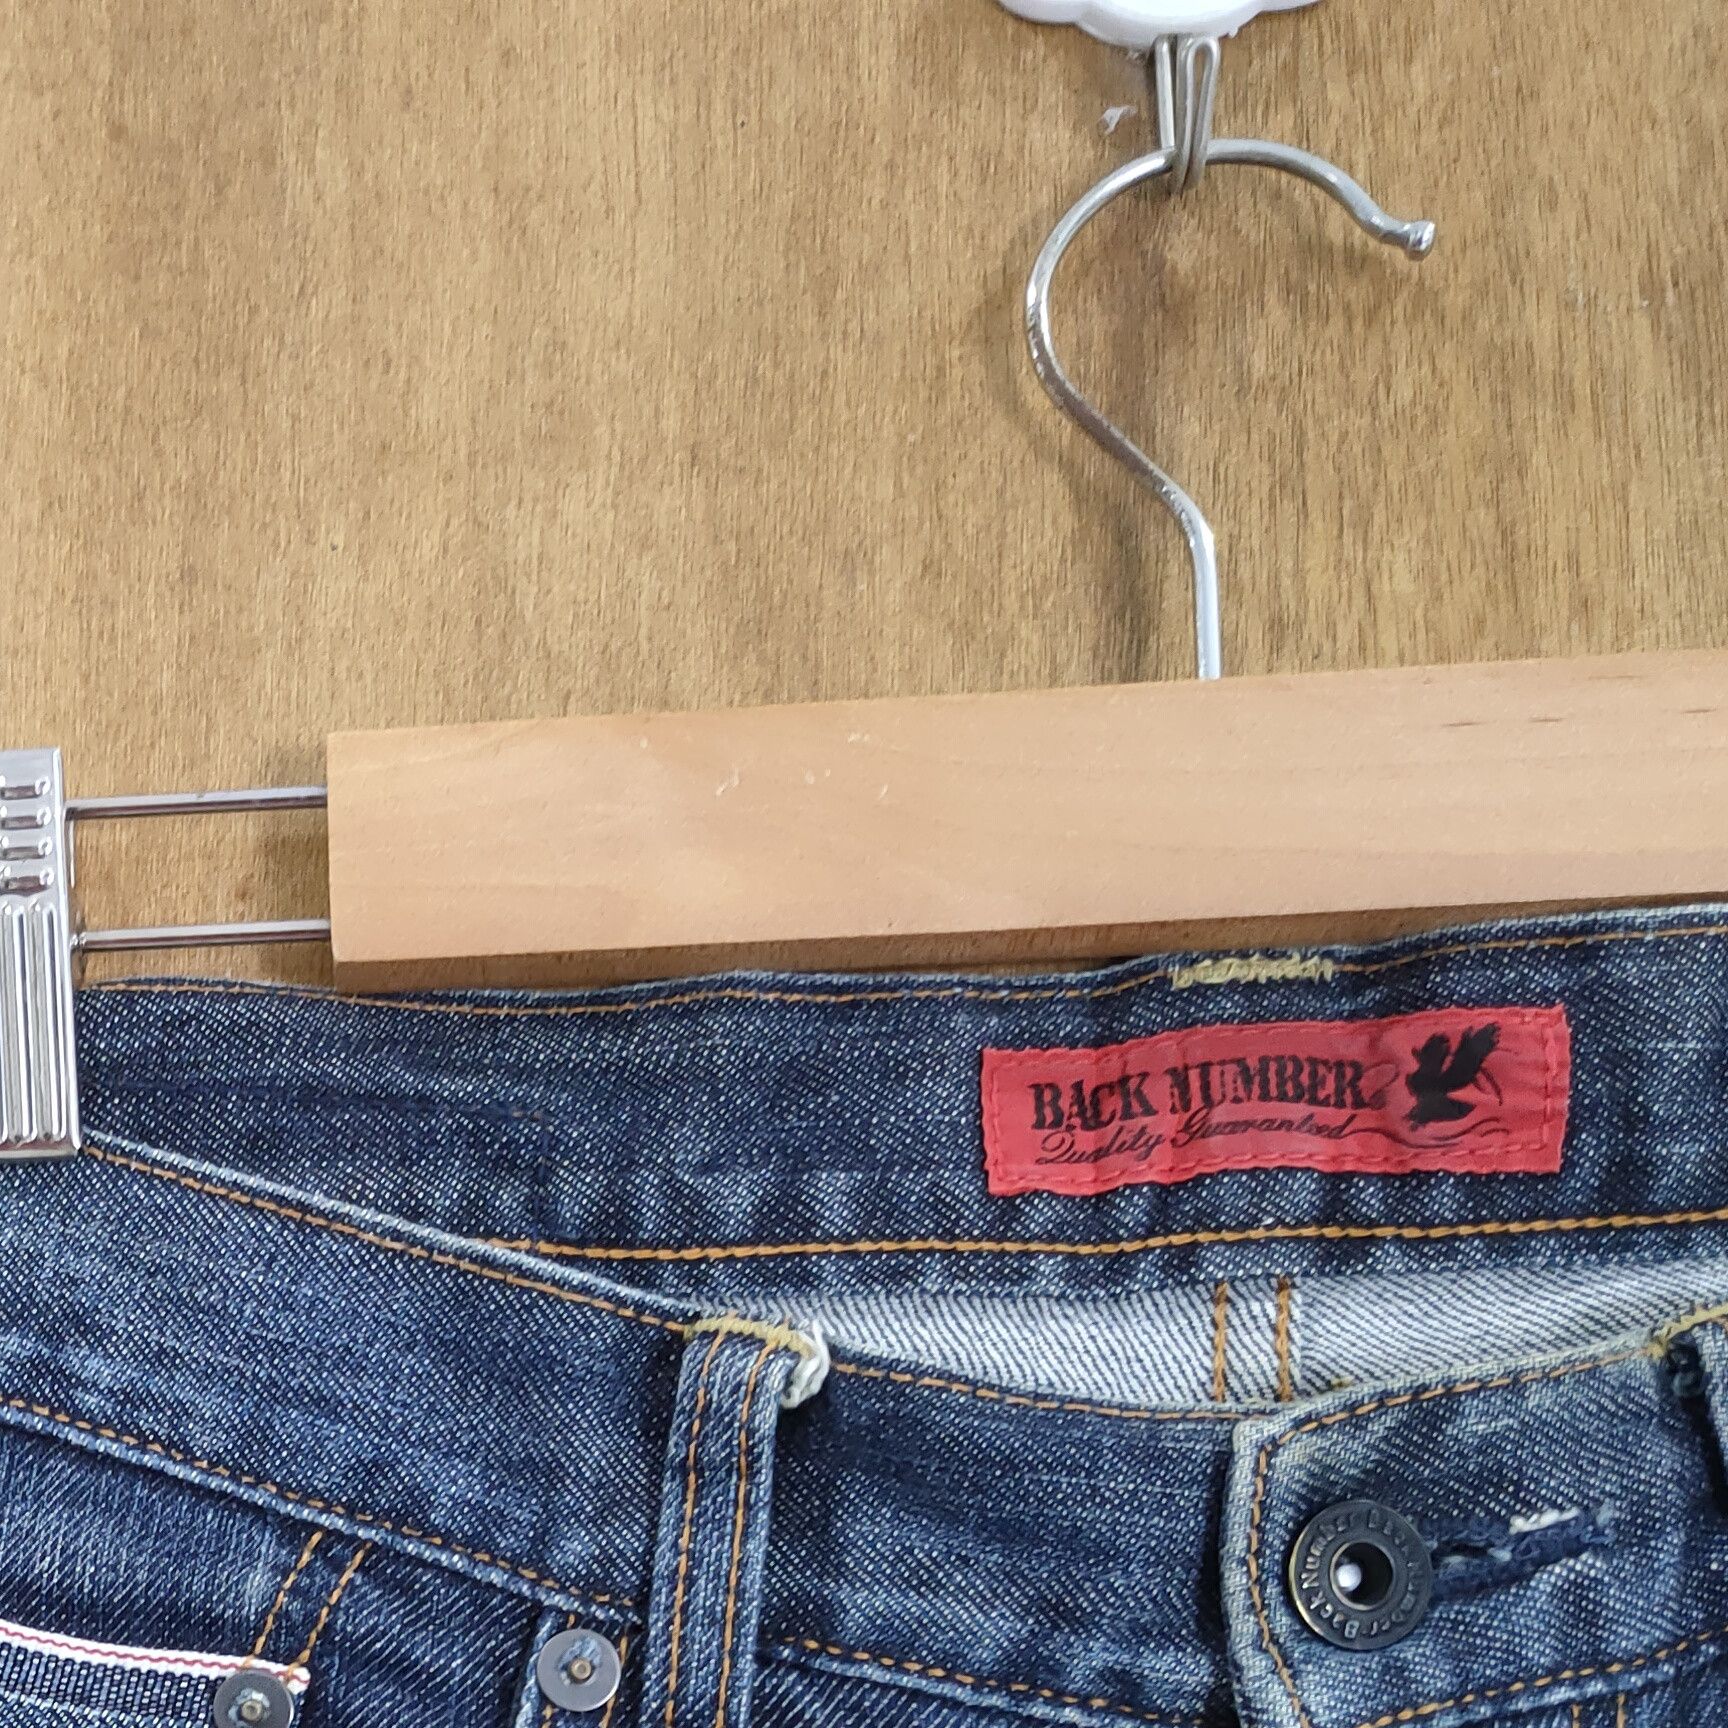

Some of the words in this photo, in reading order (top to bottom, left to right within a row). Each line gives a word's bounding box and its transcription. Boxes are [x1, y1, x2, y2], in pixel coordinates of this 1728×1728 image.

[1028, 1071, 1159, 1131] BACK
[1163, 1055, 1389, 1114] NUMBER
[1035, 1125, 1166, 1165] Quality
